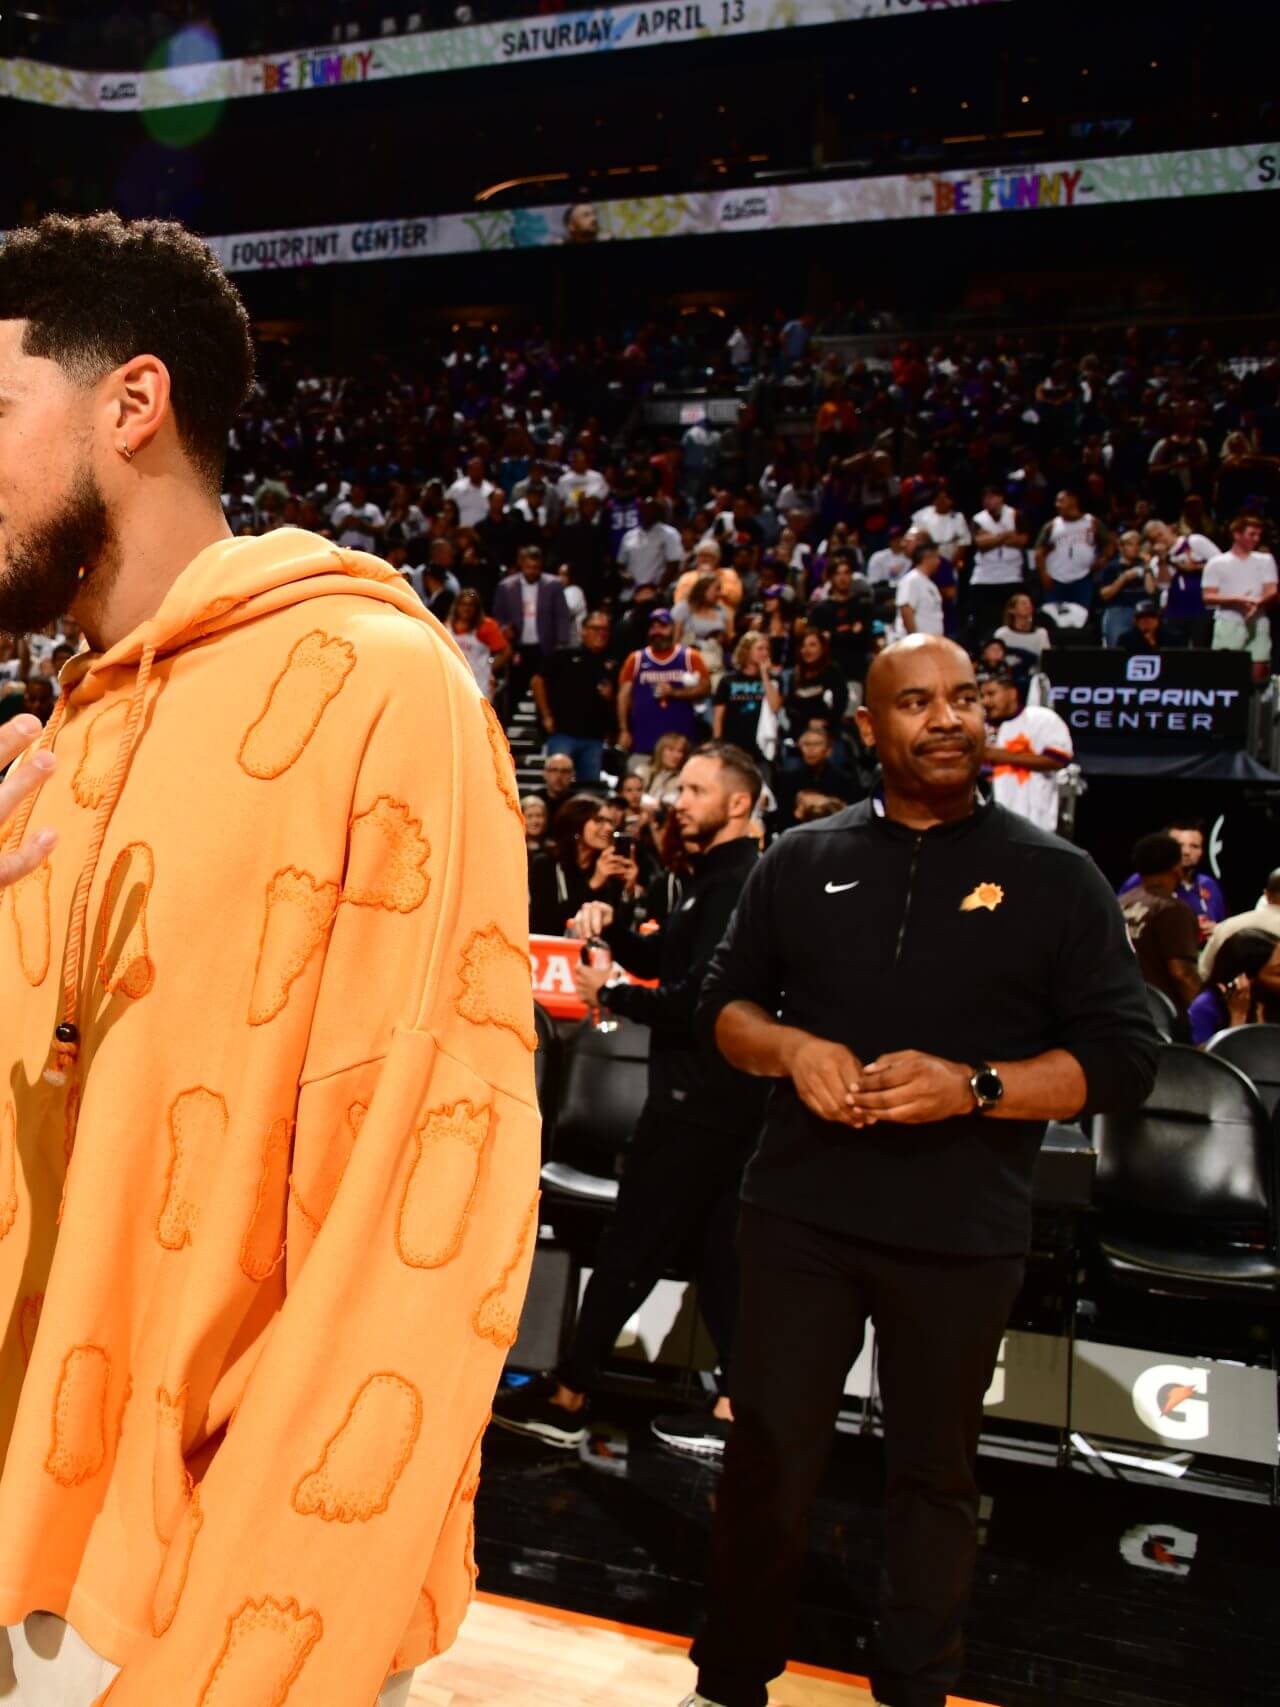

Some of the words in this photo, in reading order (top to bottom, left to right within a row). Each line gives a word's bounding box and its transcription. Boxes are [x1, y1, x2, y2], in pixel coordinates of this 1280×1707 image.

[635, 6, 707, 38] APRIL
[721, 0, 744, 26] 13
[263, 61, 291, 94] BE
[933, 178, 971, 215] BE
[981, 168, 1082, 212] FUNNY
[231, 233, 340, 267] FOOTPRINT
[351, 223, 429, 255] CENTER
[1049, 686, 1239, 708] FOOTPRINT
[1071, 709, 1214, 731] CENTER
[1132, 1364, 1211, 1440] G
